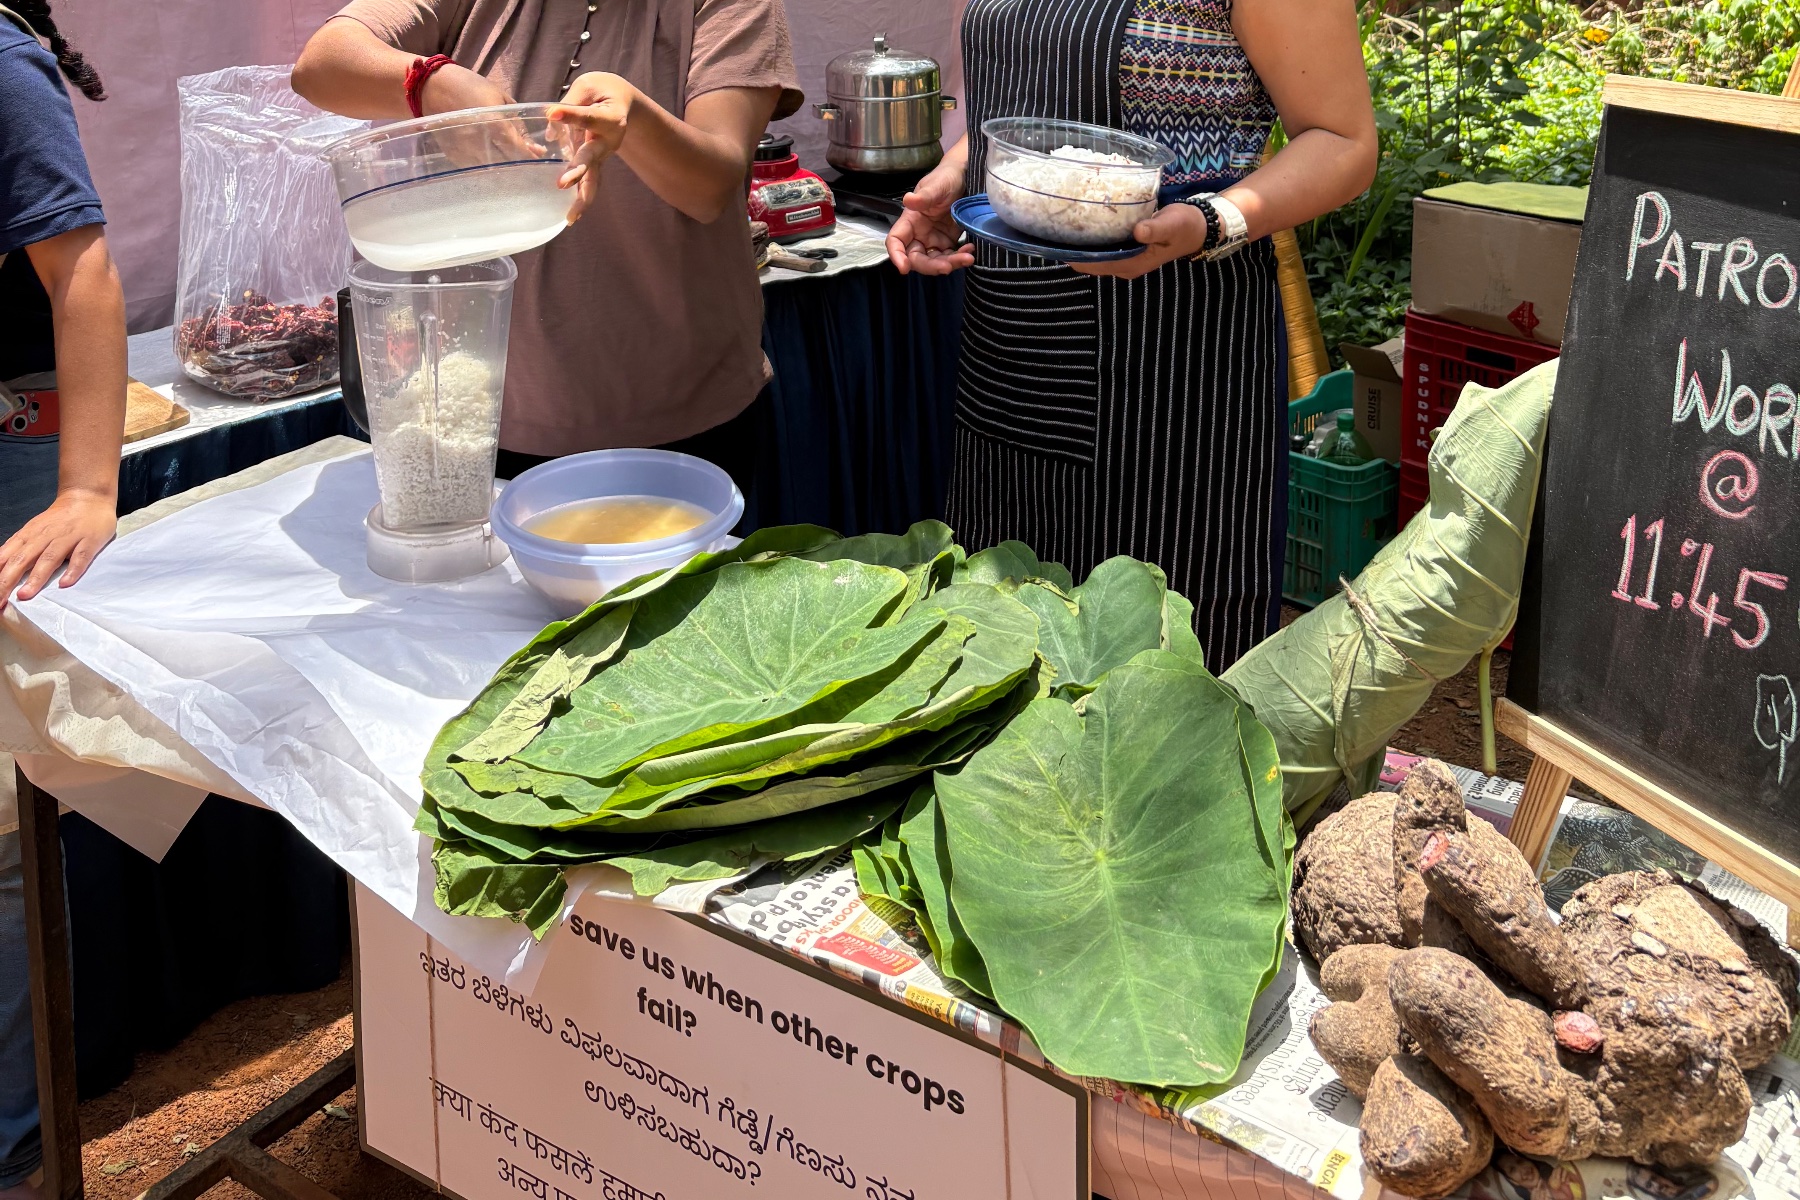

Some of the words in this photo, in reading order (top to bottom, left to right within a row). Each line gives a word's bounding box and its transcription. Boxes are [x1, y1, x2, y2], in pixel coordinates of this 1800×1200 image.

[1625, 191, 1800, 313] PATRO
[1367, 387, 1378, 430] CRUISE
[1416, 363, 1430, 450] SPUDNIK
[1699, 450, 1759, 519] @
[1611, 513, 1790, 650] 11:45
[472, 975, 553, 1035] ಬೆಳೆಗಳು
[569, 913, 636, 961] save
[642, 946, 676, 980] us
[680, 964, 764, 1025] when
[770, 1010, 859, 1067] other
[865, 1053, 965, 1115] crops
[636, 986, 697, 1038] fail?
[477, 1102, 519, 1148] कंद
[522, 1127, 595, 1185] फसलें
